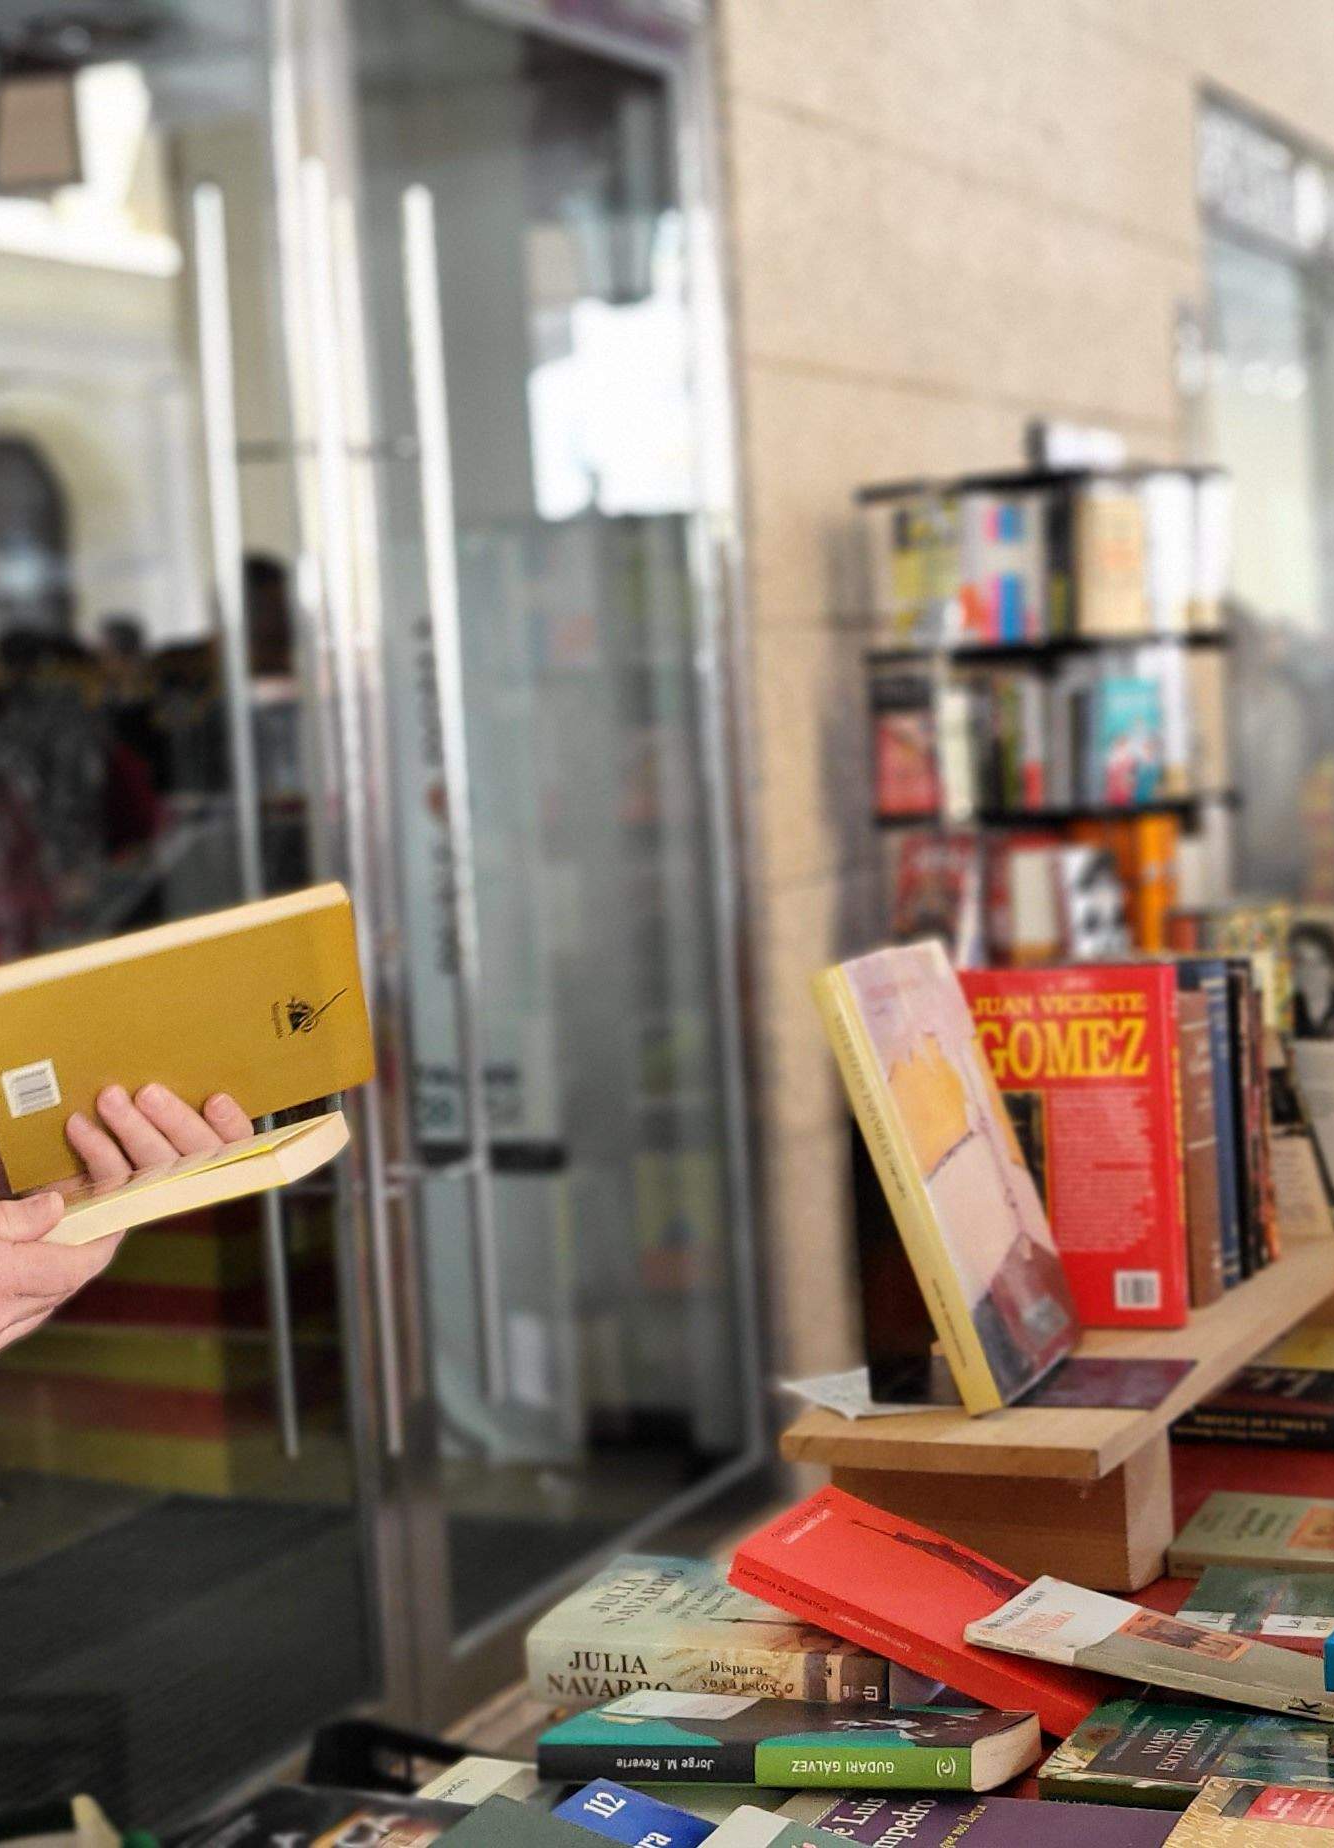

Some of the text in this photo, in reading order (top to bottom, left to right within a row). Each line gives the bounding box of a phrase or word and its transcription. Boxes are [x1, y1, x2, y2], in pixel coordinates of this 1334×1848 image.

[1038, 992, 1147, 1015] VICENTE
[972, 1018, 1150, 1080] GOMEZ
[568, 1650, 648, 1675] JULIA
[710, 1660, 768, 1677] Dispara,
[1140, 1728, 1178, 1755] VIAJES
[663, 1758, 678, 1771] M.
[681, 1758, 715, 1771] Jorge
[791, 1759, 842, 1775] GÁLVEZ
[845, 1760, 895, 1774] GUDARI
[832, 1797, 888, 1827] Luis
[873, 1799, 939, 1848] mpedro
